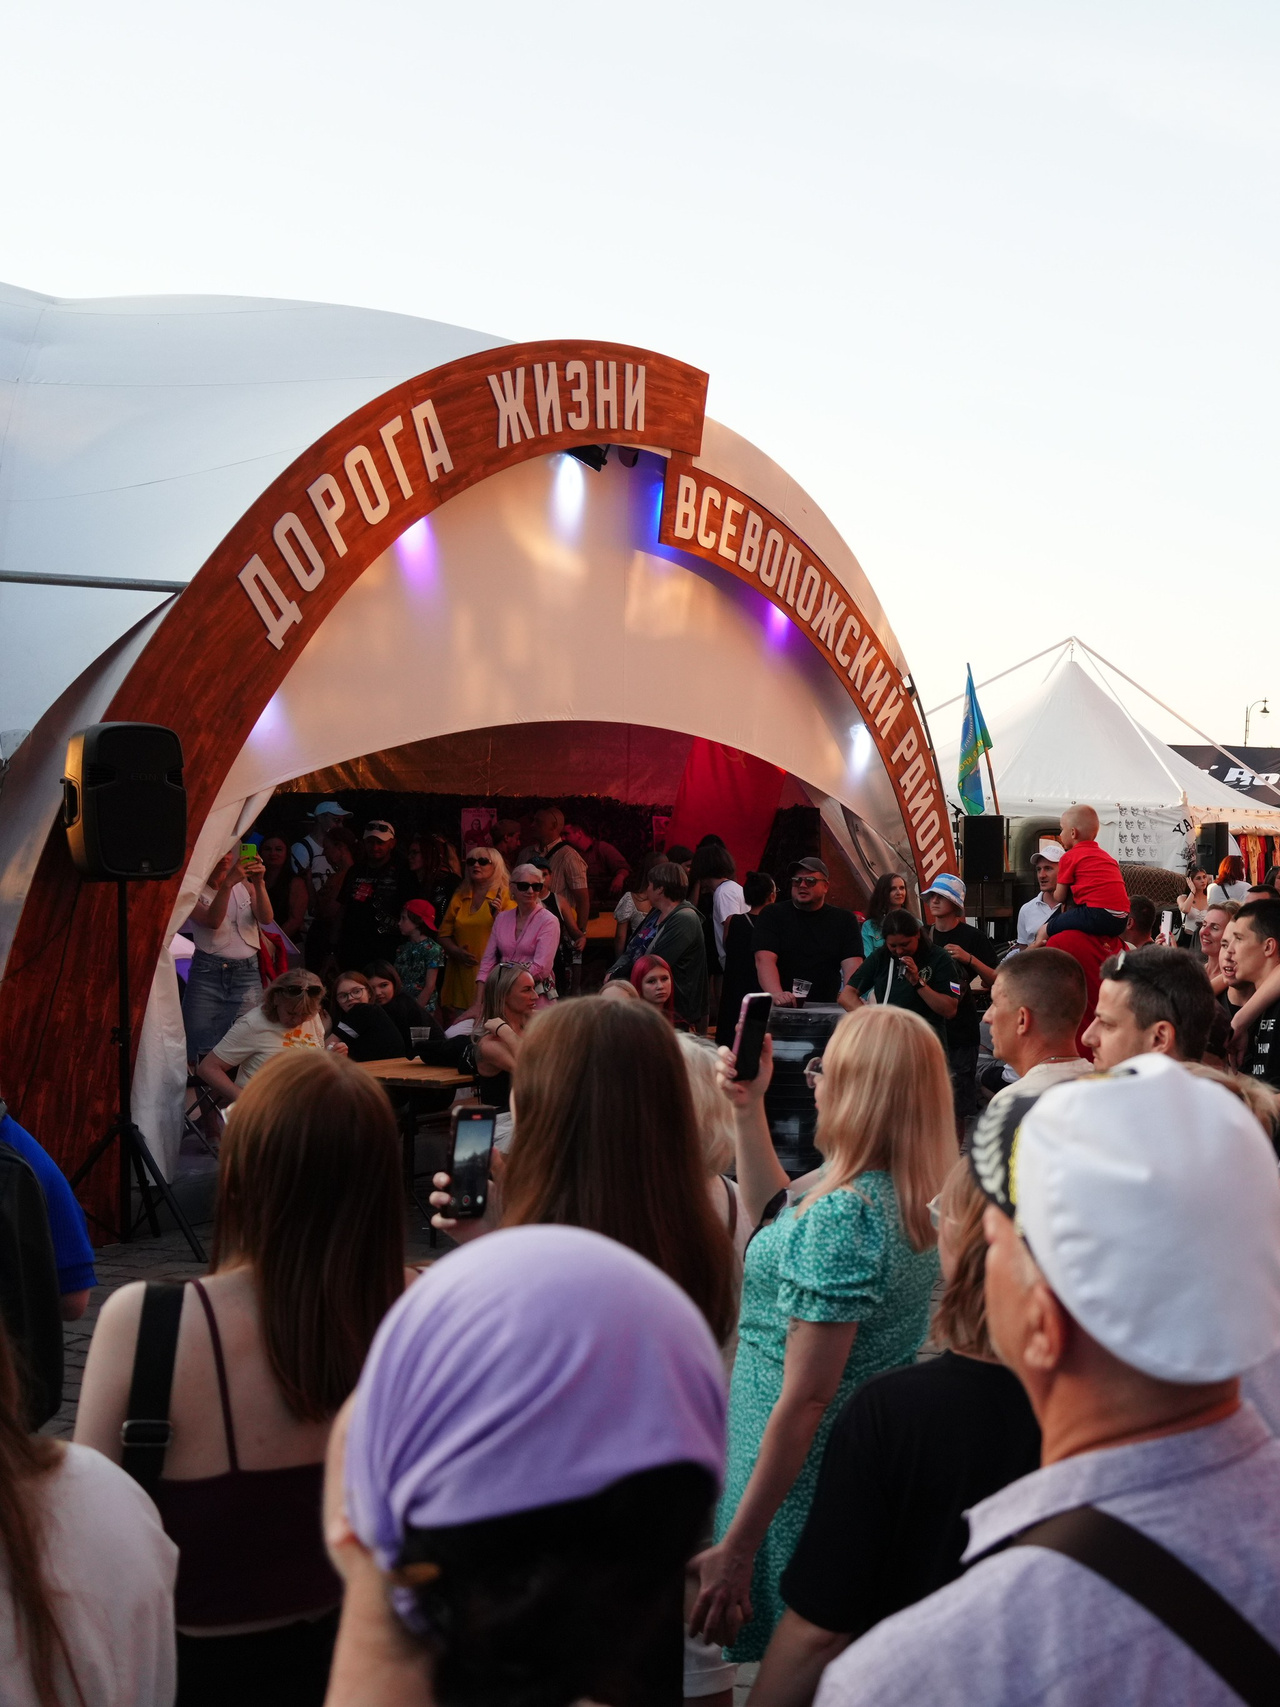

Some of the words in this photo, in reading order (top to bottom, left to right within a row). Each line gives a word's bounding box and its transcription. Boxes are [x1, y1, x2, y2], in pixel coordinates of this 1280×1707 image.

[237, 399, 454, 650] ДОРОГА
[487, 360, 646, 449] ЖИЗНИ
[674, 474, 906, 740] ВСЕВОЛОЖСКИЙ
[890, 727, 948, 883] РАЙОН
